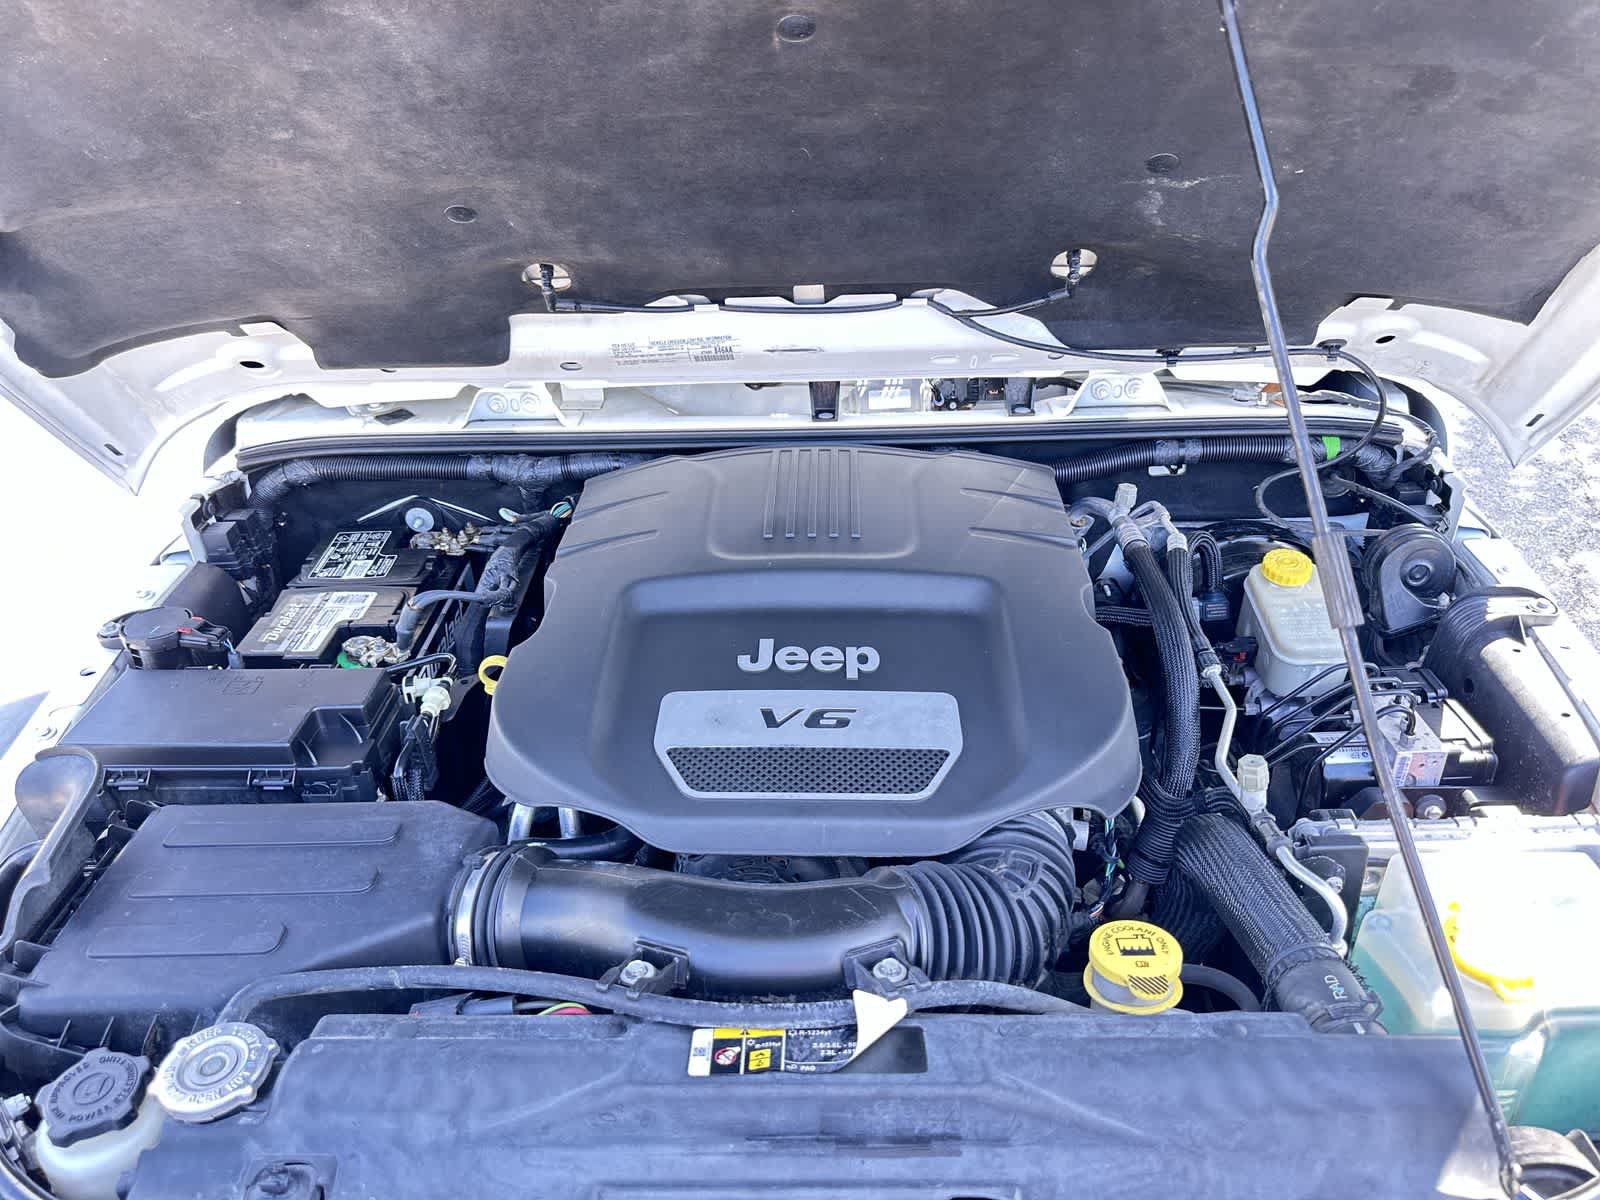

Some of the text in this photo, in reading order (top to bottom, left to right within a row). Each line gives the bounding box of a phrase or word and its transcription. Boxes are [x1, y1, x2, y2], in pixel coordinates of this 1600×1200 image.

[737, 638, 881, 680] Jeep
[760, 707, 858, 729] V6
[1111, 925, 1157, 937] COOLANT
